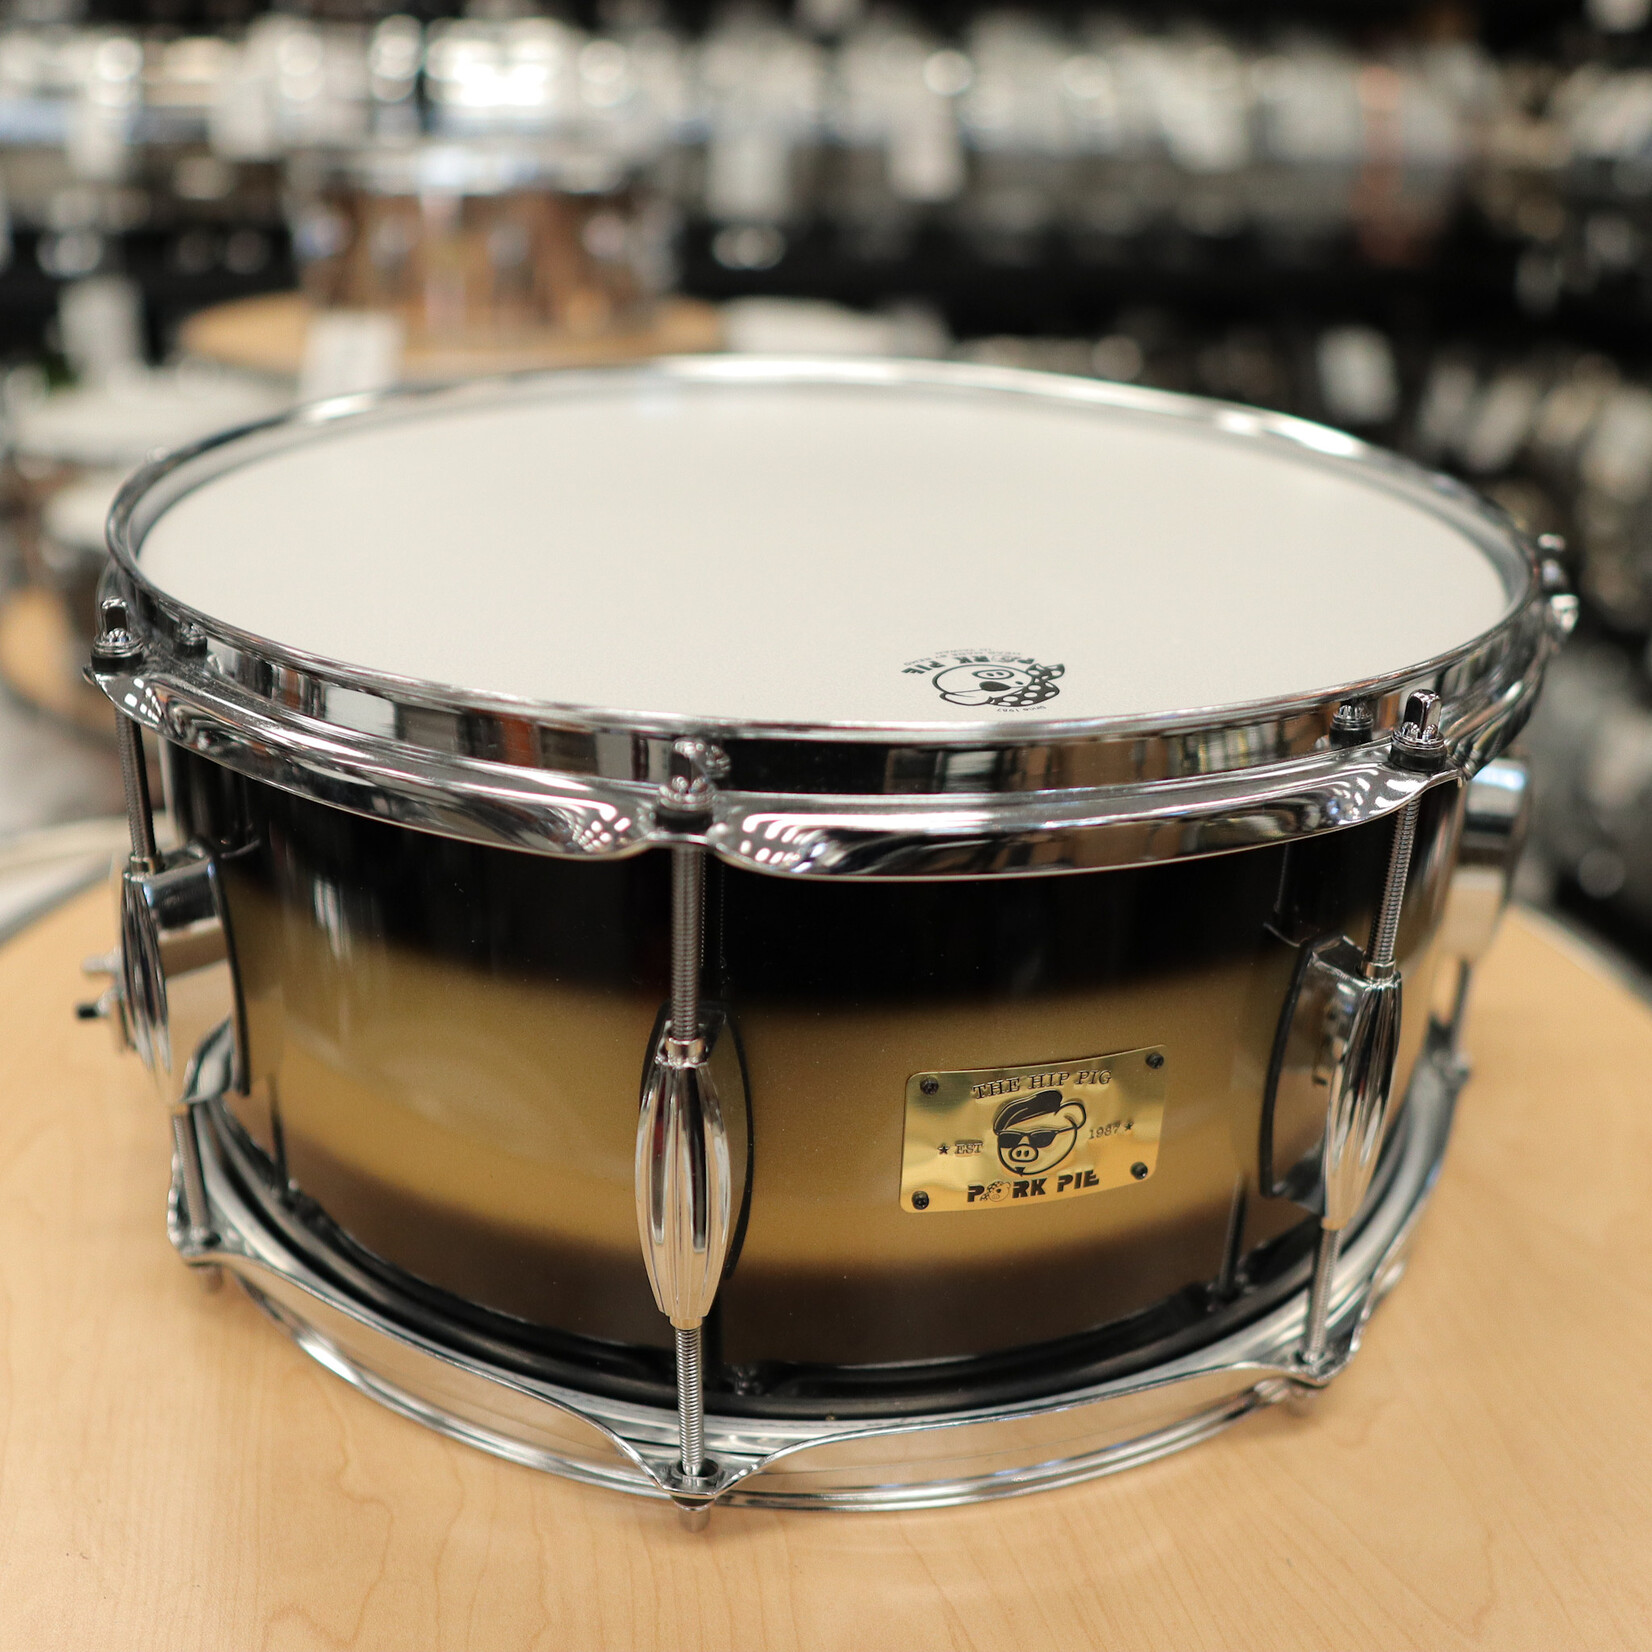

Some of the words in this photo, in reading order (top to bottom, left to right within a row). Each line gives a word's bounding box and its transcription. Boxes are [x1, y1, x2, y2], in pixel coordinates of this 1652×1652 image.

[901, 660, 945, 674] PIE
[972, 1078, 1021, 1100] THE
[1028, 1071, 1070, 1090] HIP
[1075, 1069, 1112, 1086] PIG
[954, 1141, 984, 1156] EST
[1088, 1122, 1121, 1141] 1987
[966, 1178, 1048, 1203] PORK
[1056, 1168, 1100, 1193] PIE
